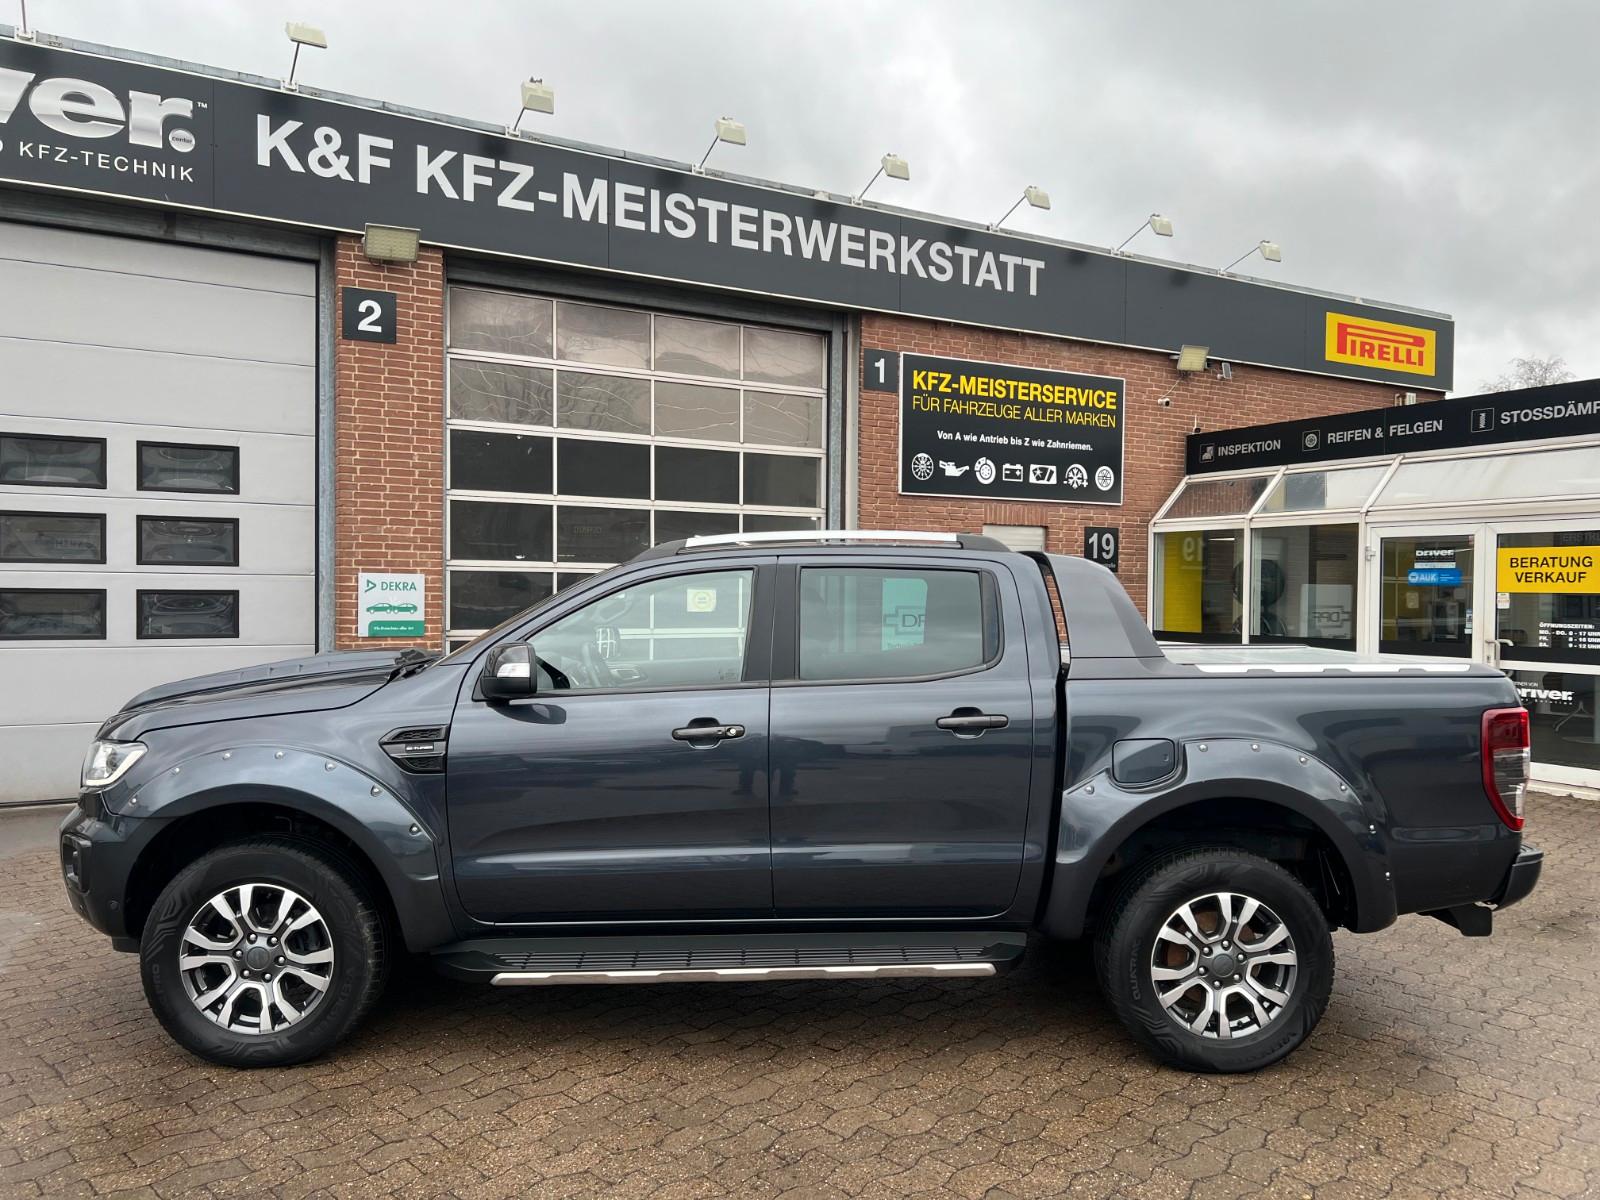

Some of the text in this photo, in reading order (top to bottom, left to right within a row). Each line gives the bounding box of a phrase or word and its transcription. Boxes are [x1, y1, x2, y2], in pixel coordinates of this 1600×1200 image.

[19, 141, 194, 183] KFZ-TECHNIK
[257, 113, 1045, 296] K&F KFZ-MEISTERWERKSTATT
[357, 299, 382, 333] 2
[1336, 322, 1426, 367] PIRELLI
[874, 357, 885, 384] 1
[912, 369, 1117, 410] KFZ-MEISTERSERVICE
[912, 393, 1116, 428] FÜR FAHRZEUGE ALLER MARKEN
[937, 430, 1093, 451] Von A wie Antrieb bis Z wie Zahnriemen.
[1327, 419, 1443, 444] REIFEN & FELGEN
[1218, 439, 1281, 457] INSPEKTION
[1088, 532, 1115, 560] 19
[1509, 556, 1593, 568] BERATUNG
[381, 581, 417, 591] DEKRA
[1515, 571, 1587, 583] VERKAUF
